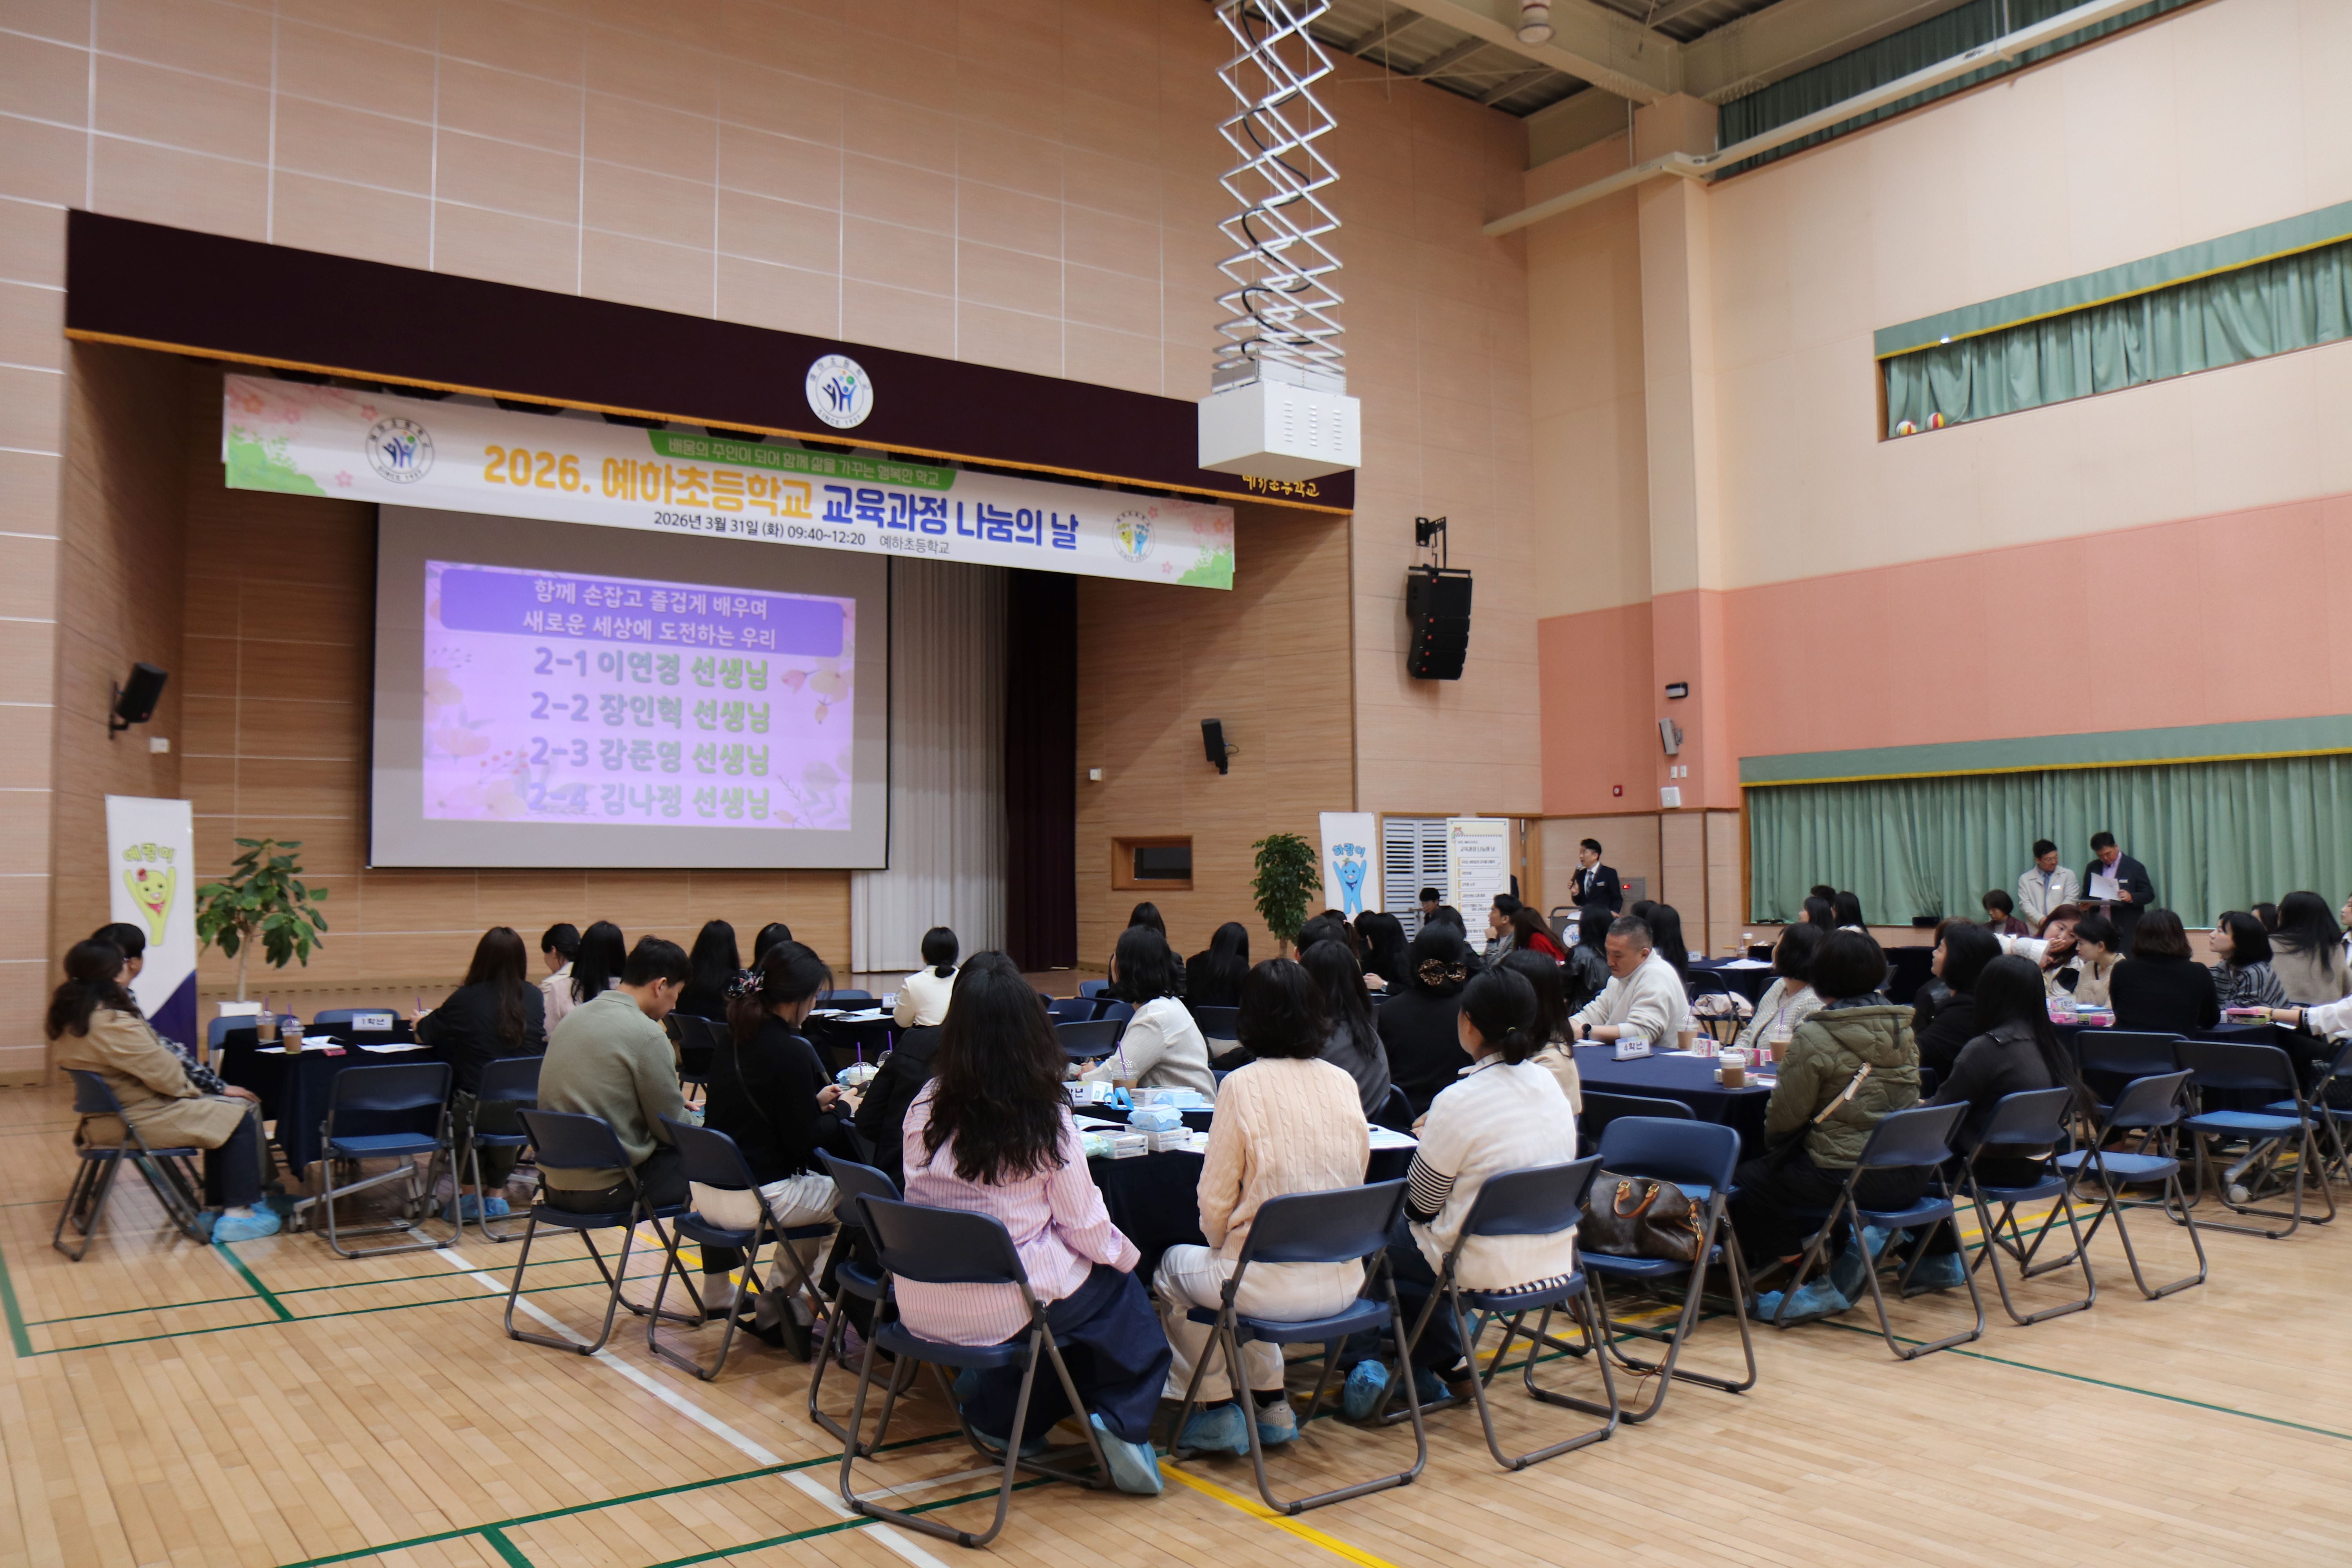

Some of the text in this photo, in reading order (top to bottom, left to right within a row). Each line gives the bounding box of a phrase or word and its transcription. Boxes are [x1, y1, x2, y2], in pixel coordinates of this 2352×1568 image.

[668, 438, 939, 486] 배움의 주인이 되어 함께 삶을 가꾸는 행복한 학교
[483, 445, 1079, 550] 2026. 예하초등학교 교육과정 나눔의 날
[653, 512, 950, 555] 2026년 3월 31일 (화) 09:40~12:20 예하초등학교
[534, 578, 768, 620] 함께 손잡고 즐겁게 배우며
[522, 610, 776, 650] 새로운 세상에 도전하는 우리
[534, 646, 769, 691] 2-1 이연경 선생님
[530, 691, 771, 733] 2-2 장인혁 선생님
[529, 736, 589, 767] 2-3
[691, 742, 770, 777] 선생님
[527, 781, 770, 820] 2-4 김나정 선생님
[122, 842, 175, 864] 예랑이
[1332, 843, 1366, 858] 하랑이
[1624, 1041, 1642, 1051] 4학년
